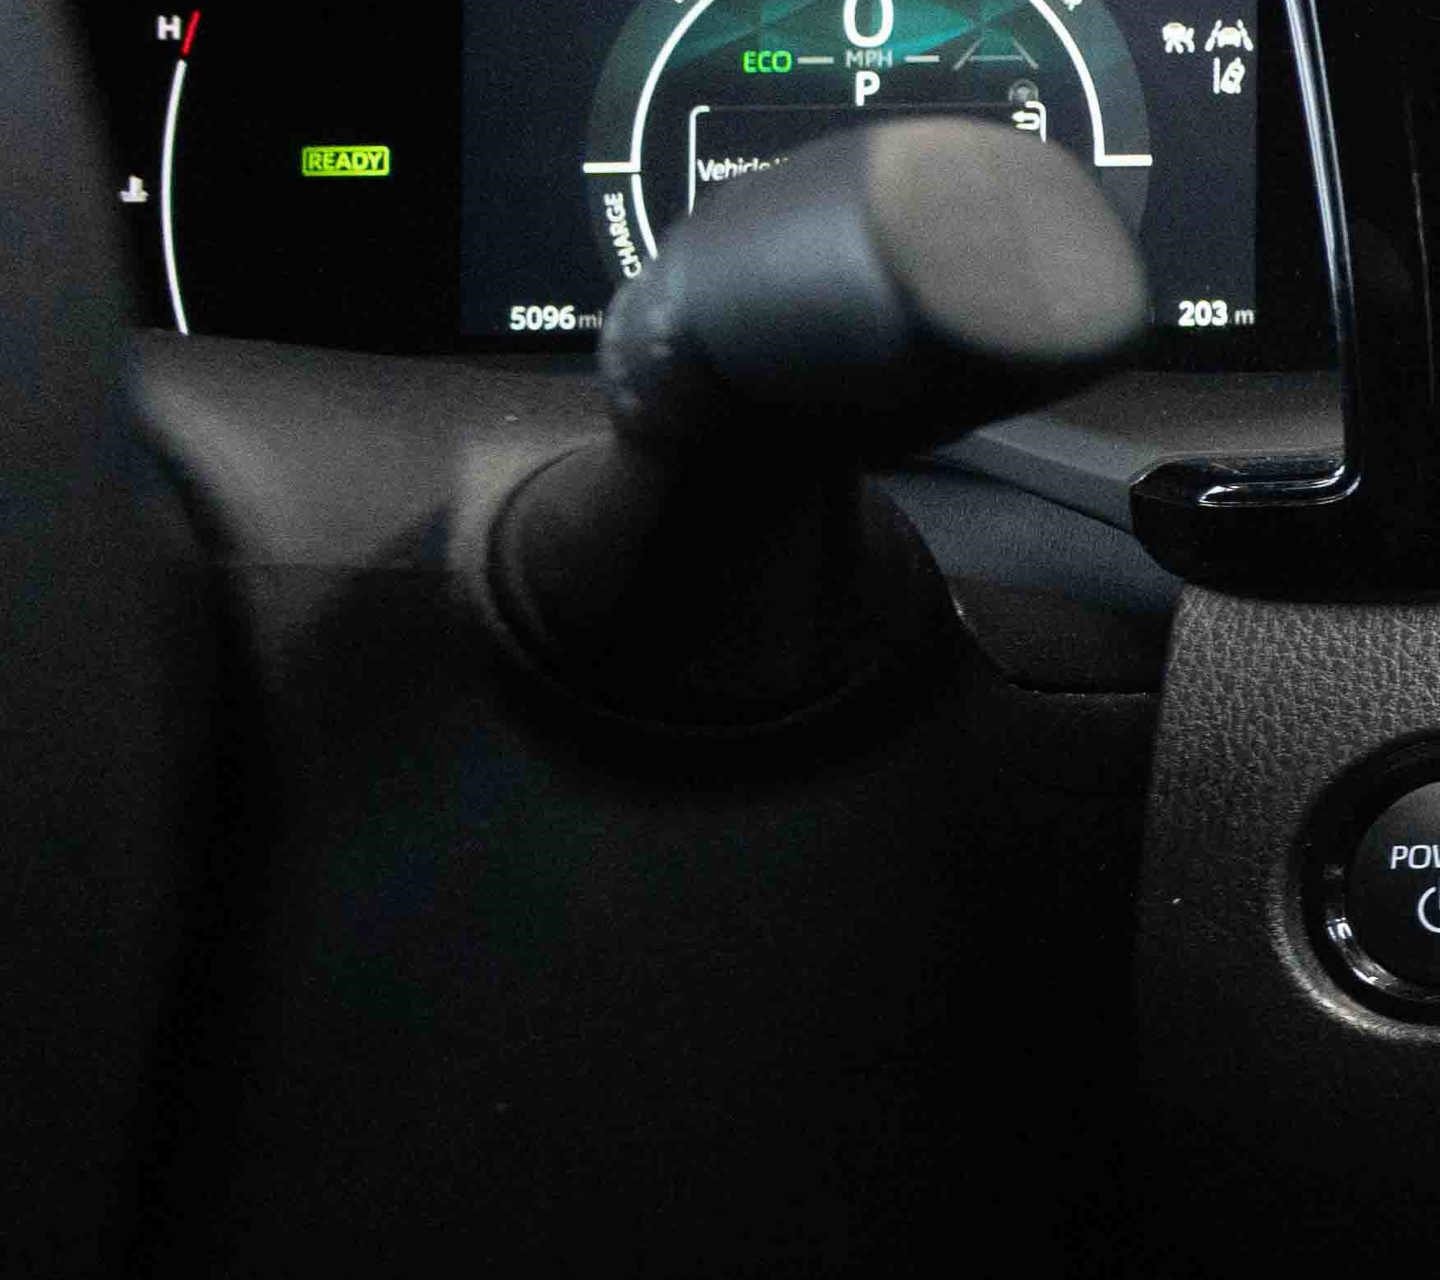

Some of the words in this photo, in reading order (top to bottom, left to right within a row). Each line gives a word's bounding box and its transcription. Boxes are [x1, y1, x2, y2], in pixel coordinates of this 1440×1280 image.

[157, 14, 182, 40] H
[742, 50, 793, 74] ECO
[845, 50, 893, 68] MPH
[854, 70, 881, 107] P
[307, 152, 384, 170] READY
[603, 191, 643, 280] CHARGE
[509, 305, 576, 330] 5096
[1178, 299, 1229, 327] 203
